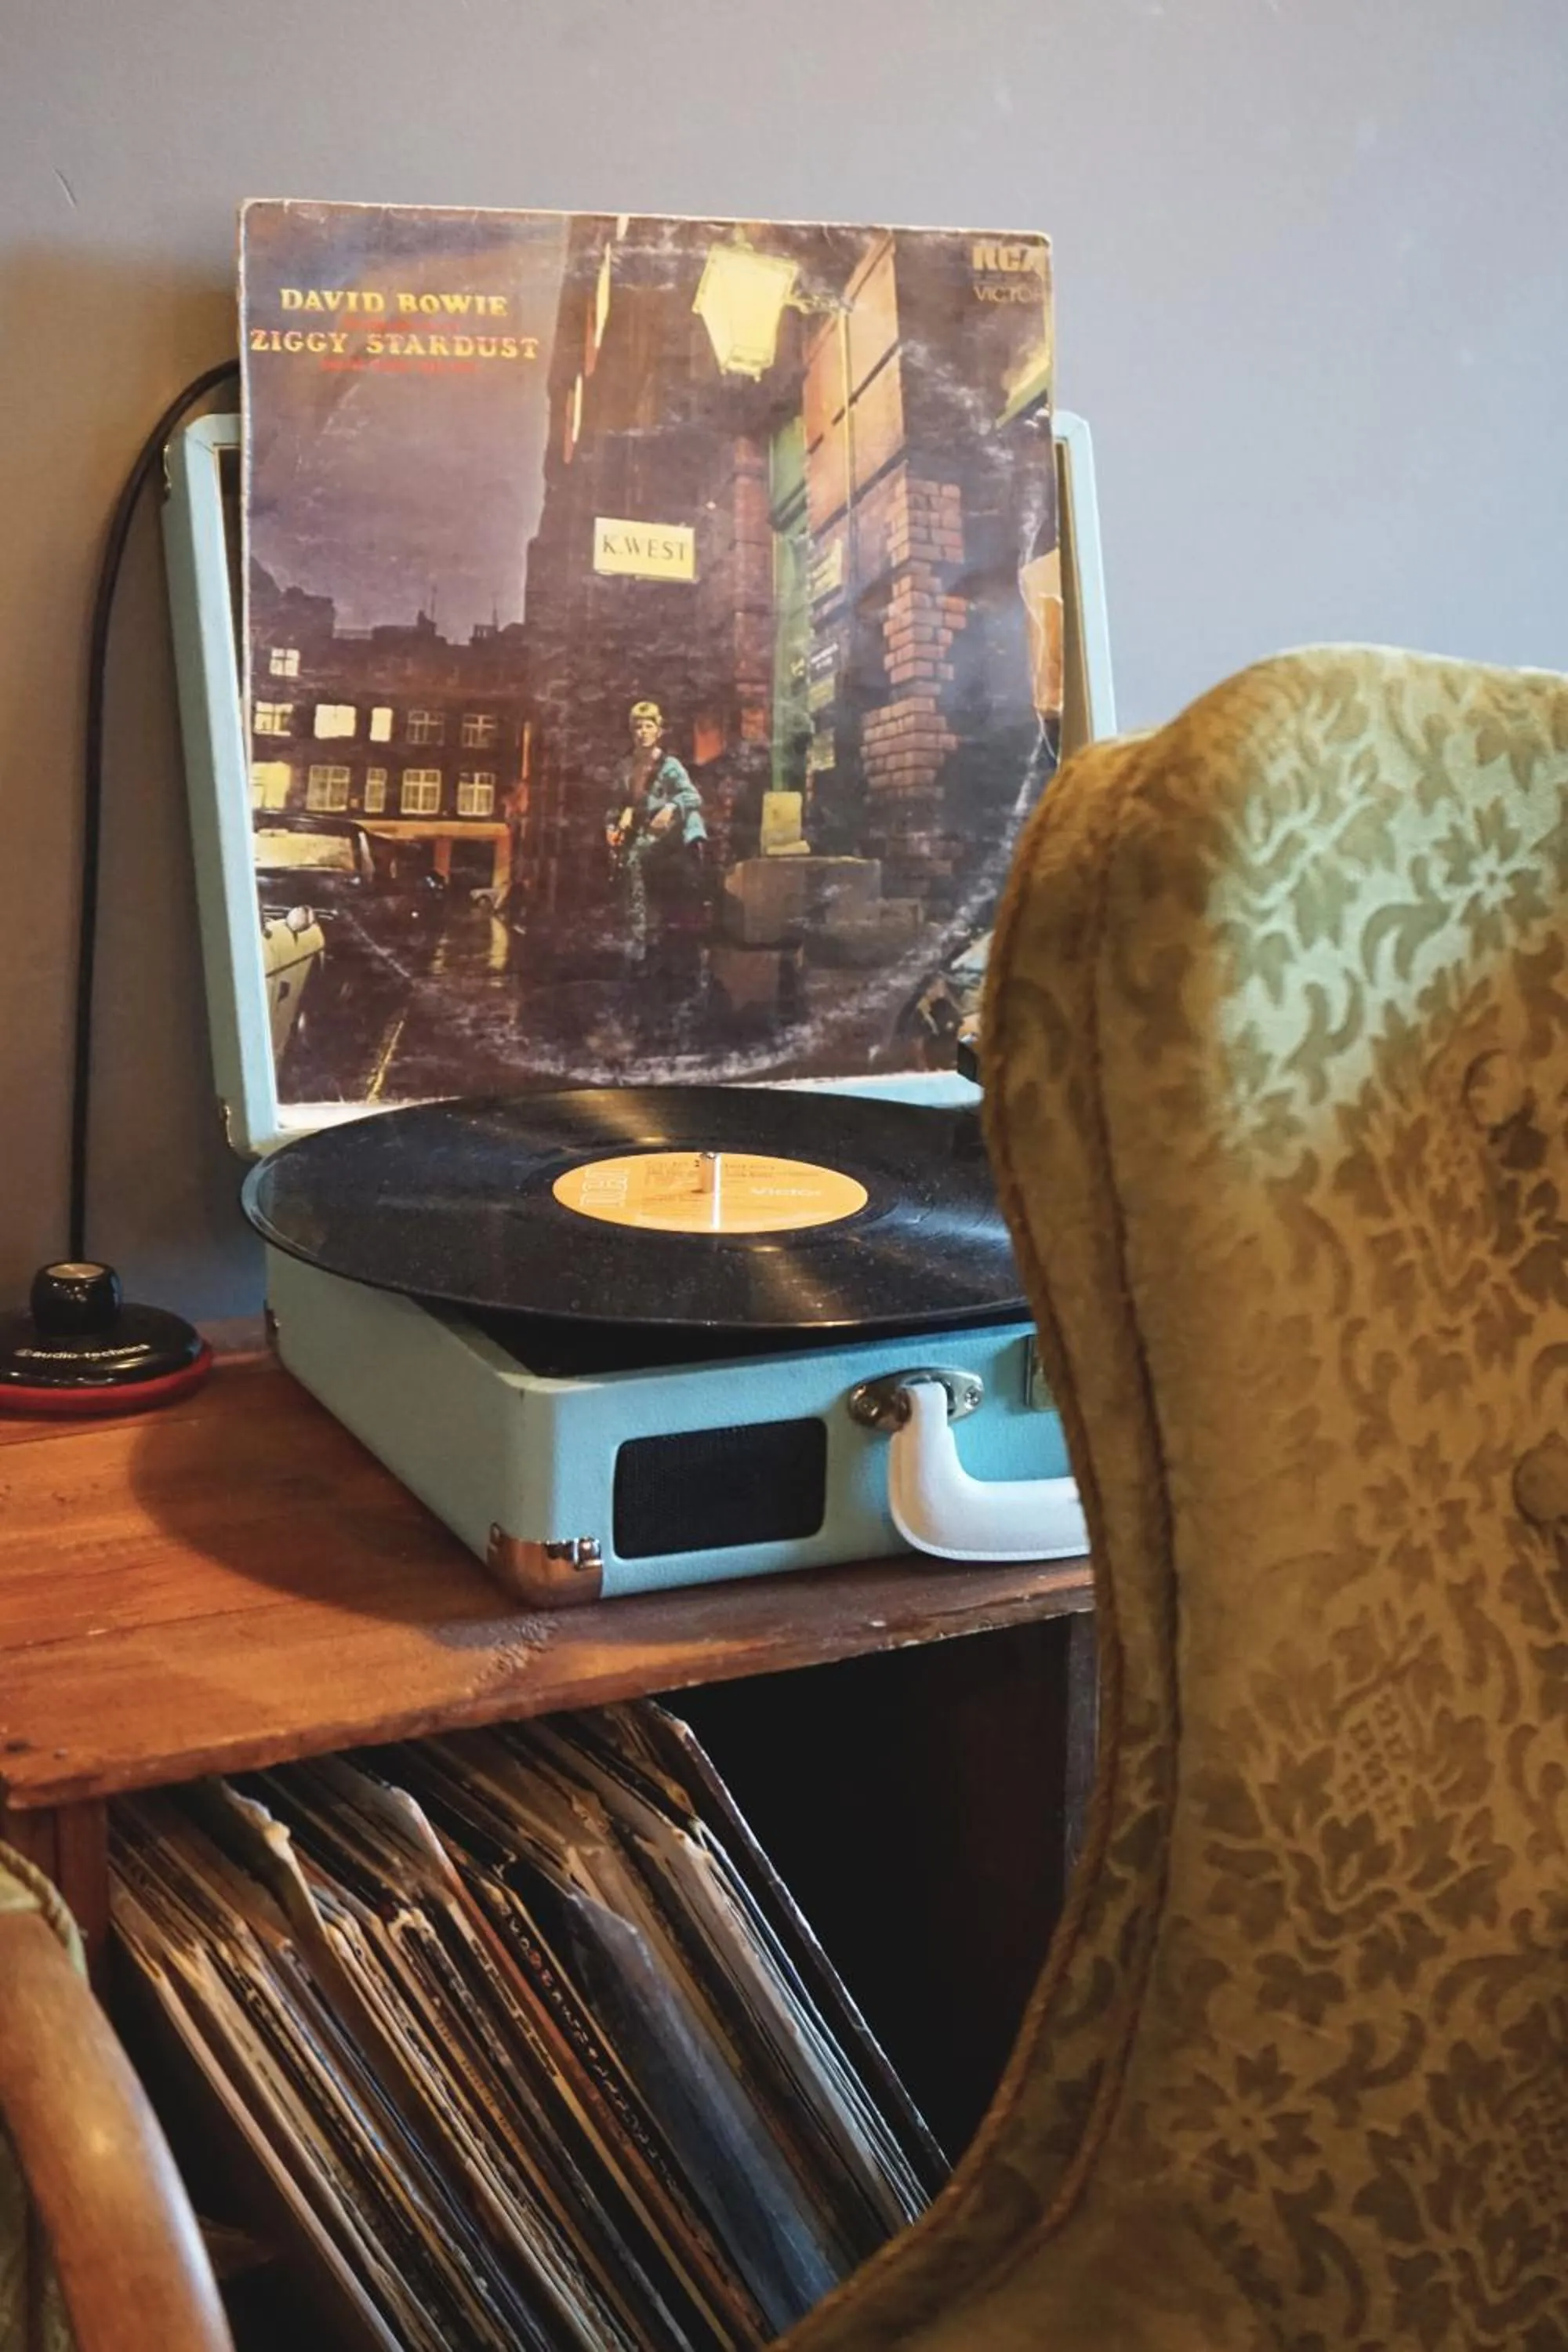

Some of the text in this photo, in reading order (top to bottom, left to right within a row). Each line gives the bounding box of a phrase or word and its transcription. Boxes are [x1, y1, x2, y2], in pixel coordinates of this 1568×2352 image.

[280, 288, 509, 316] DAVID BOWIE
[250, 328, 539, 359] ZIGGY STARDUST
